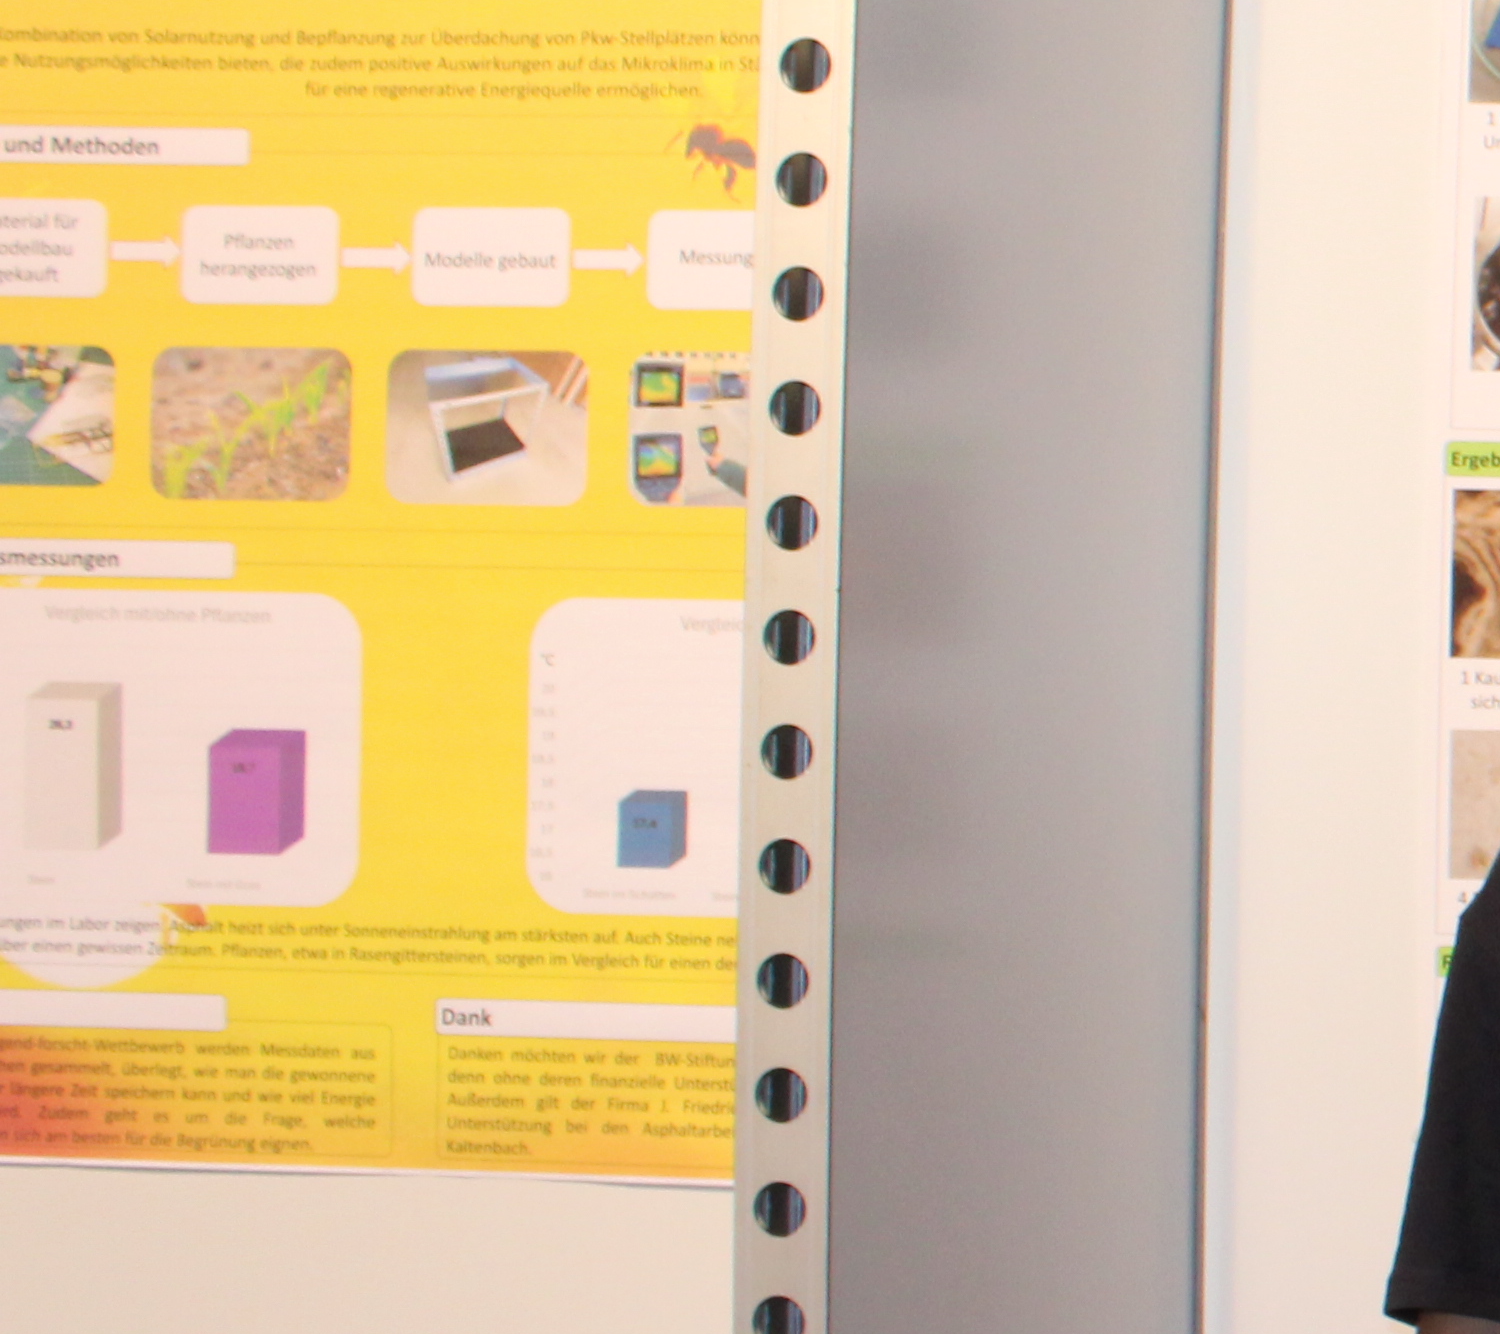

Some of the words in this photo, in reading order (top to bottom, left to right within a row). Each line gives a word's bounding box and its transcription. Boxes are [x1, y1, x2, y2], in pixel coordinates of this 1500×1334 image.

[3, 136, 45, 154] und
[50, 137, 159, 155] Methoden
[425, 252, 495, 268] Modelle
[498, 253, 557, 272] gebaut
[441, 1007, 492, 1028] Dank
